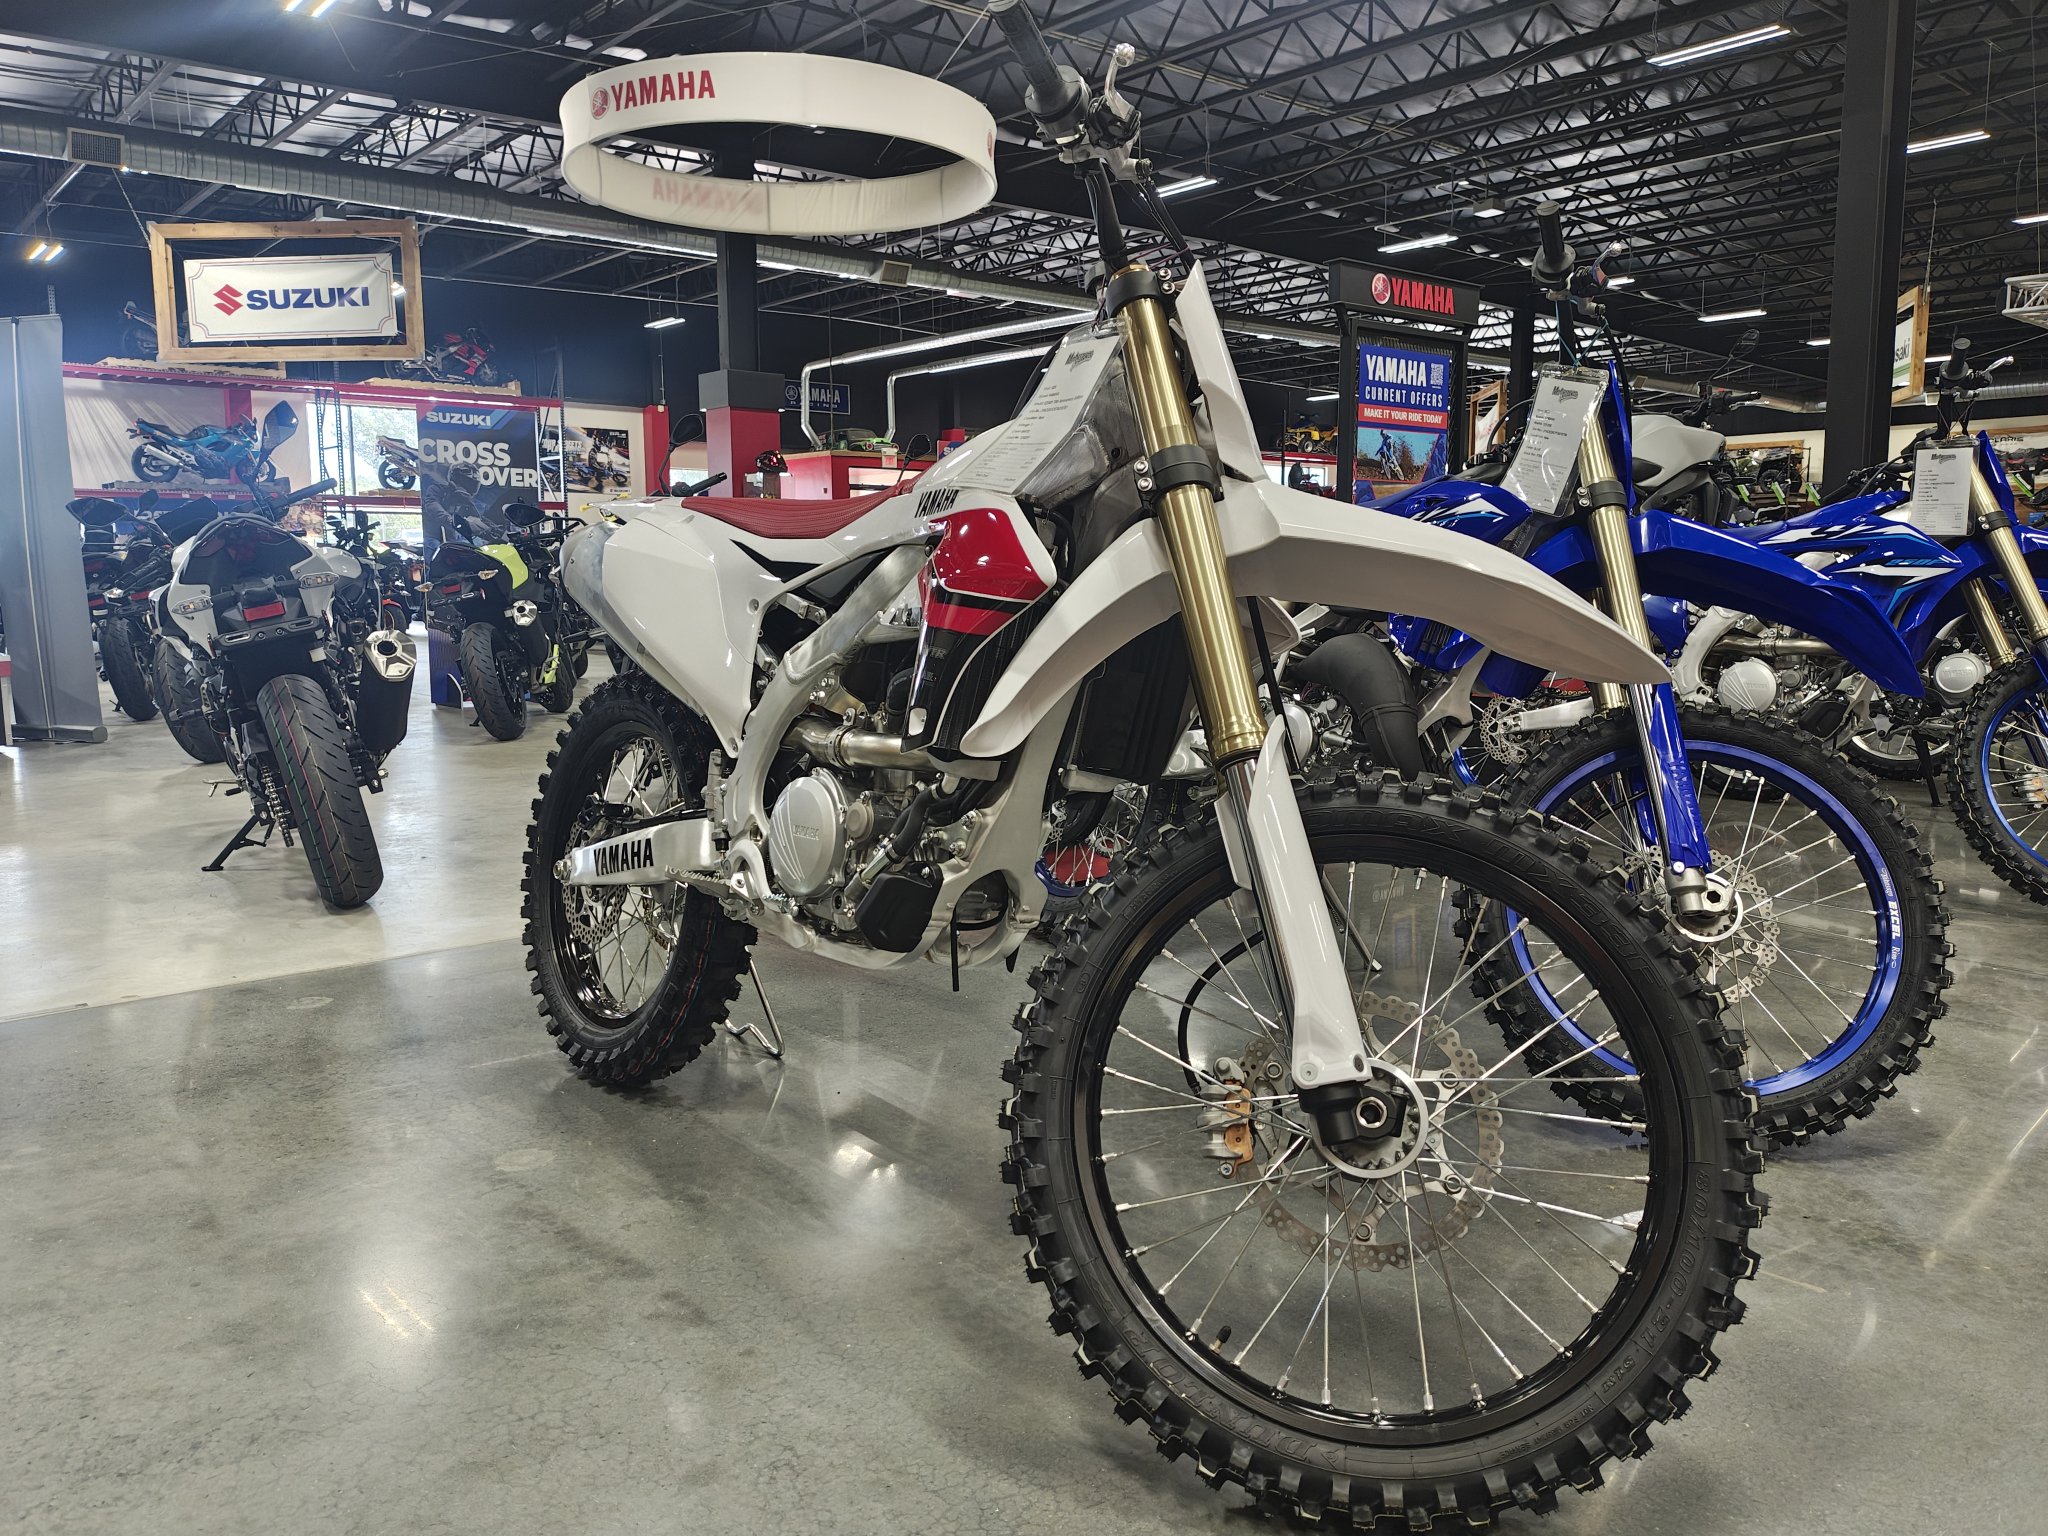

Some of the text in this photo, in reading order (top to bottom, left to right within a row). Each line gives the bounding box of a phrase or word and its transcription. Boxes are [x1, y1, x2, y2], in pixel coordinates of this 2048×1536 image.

[610, 70, 716, 112] YAMAHA
[246, 286, 370, 311] SUZUKI
[1391, 277, 1455, 315] YAMAHA
[1365, 354, 1427, 387] YAMAHA
[1365, 385, 1443, 408] CURRENT OFFERS
[426, 411, 491, 426] SUZUKI
[1364, 407, 1443, 424] MAKE IT YOUR RIDE TODAY
[419, 438, 511, 467] CROSS
[479, 466, 539, 488] OVER
[914, 488, 960, 519] YAMAHA
[593, 837, 655, 877] YAMAHA
[1888, 900, 1901, 940] EXCEL
